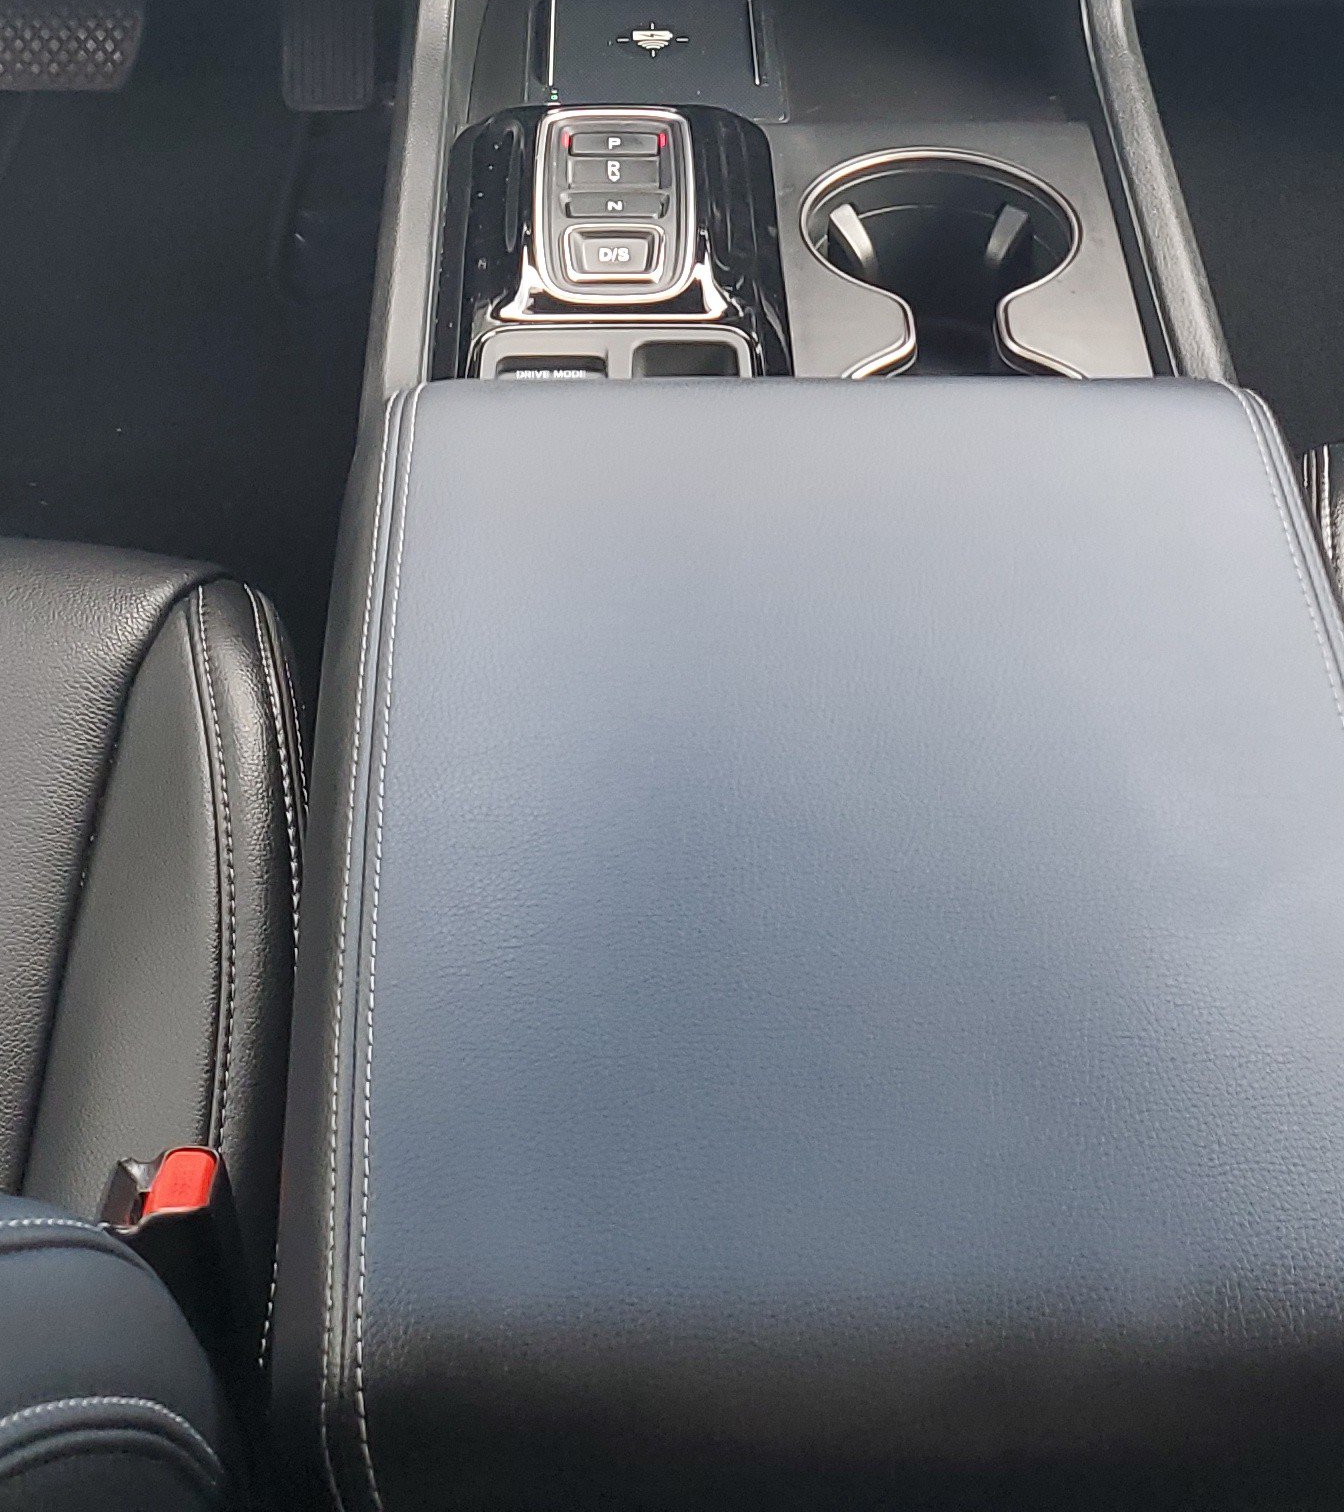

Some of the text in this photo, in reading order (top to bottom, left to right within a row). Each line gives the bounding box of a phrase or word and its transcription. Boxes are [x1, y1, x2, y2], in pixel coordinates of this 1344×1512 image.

[608, 137, 622, 150] P
[607, 200, 623, 211] N
[598, 247, 630, 263] D/S
[516, 370, 586, 379] DRIVE MODE
